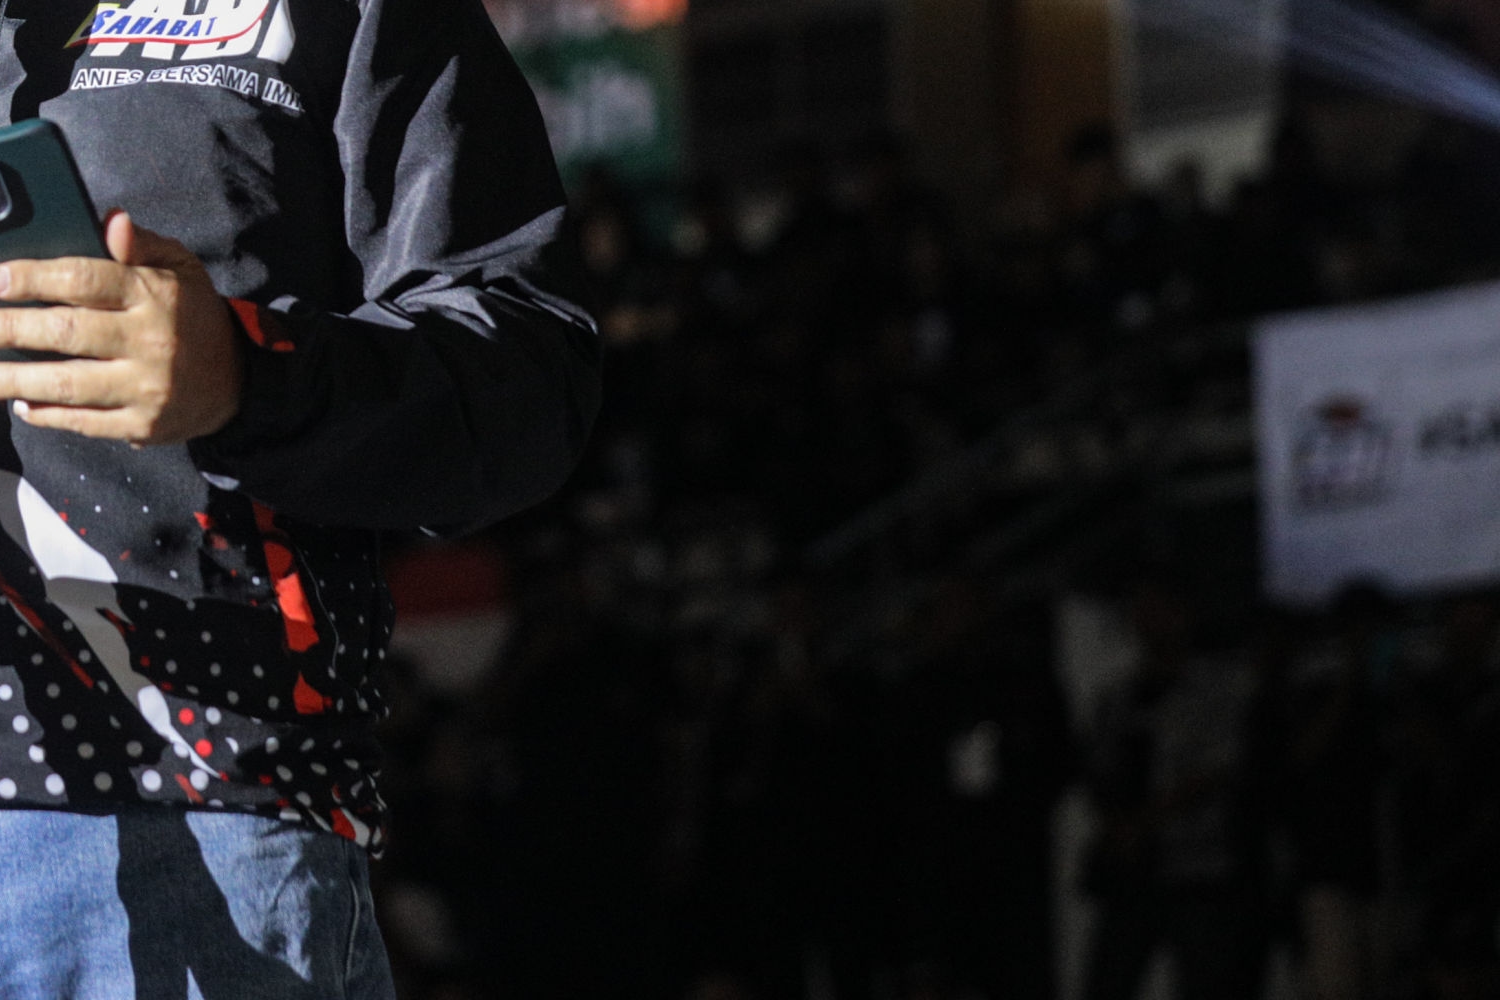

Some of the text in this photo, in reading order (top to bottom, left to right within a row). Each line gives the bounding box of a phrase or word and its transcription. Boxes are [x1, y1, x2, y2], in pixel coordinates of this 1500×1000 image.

[79, 9, 218, 37] SAHABAT
[71, 68, 144, 90] ANIES
[146, 64, 260, 97] BERSAMA
